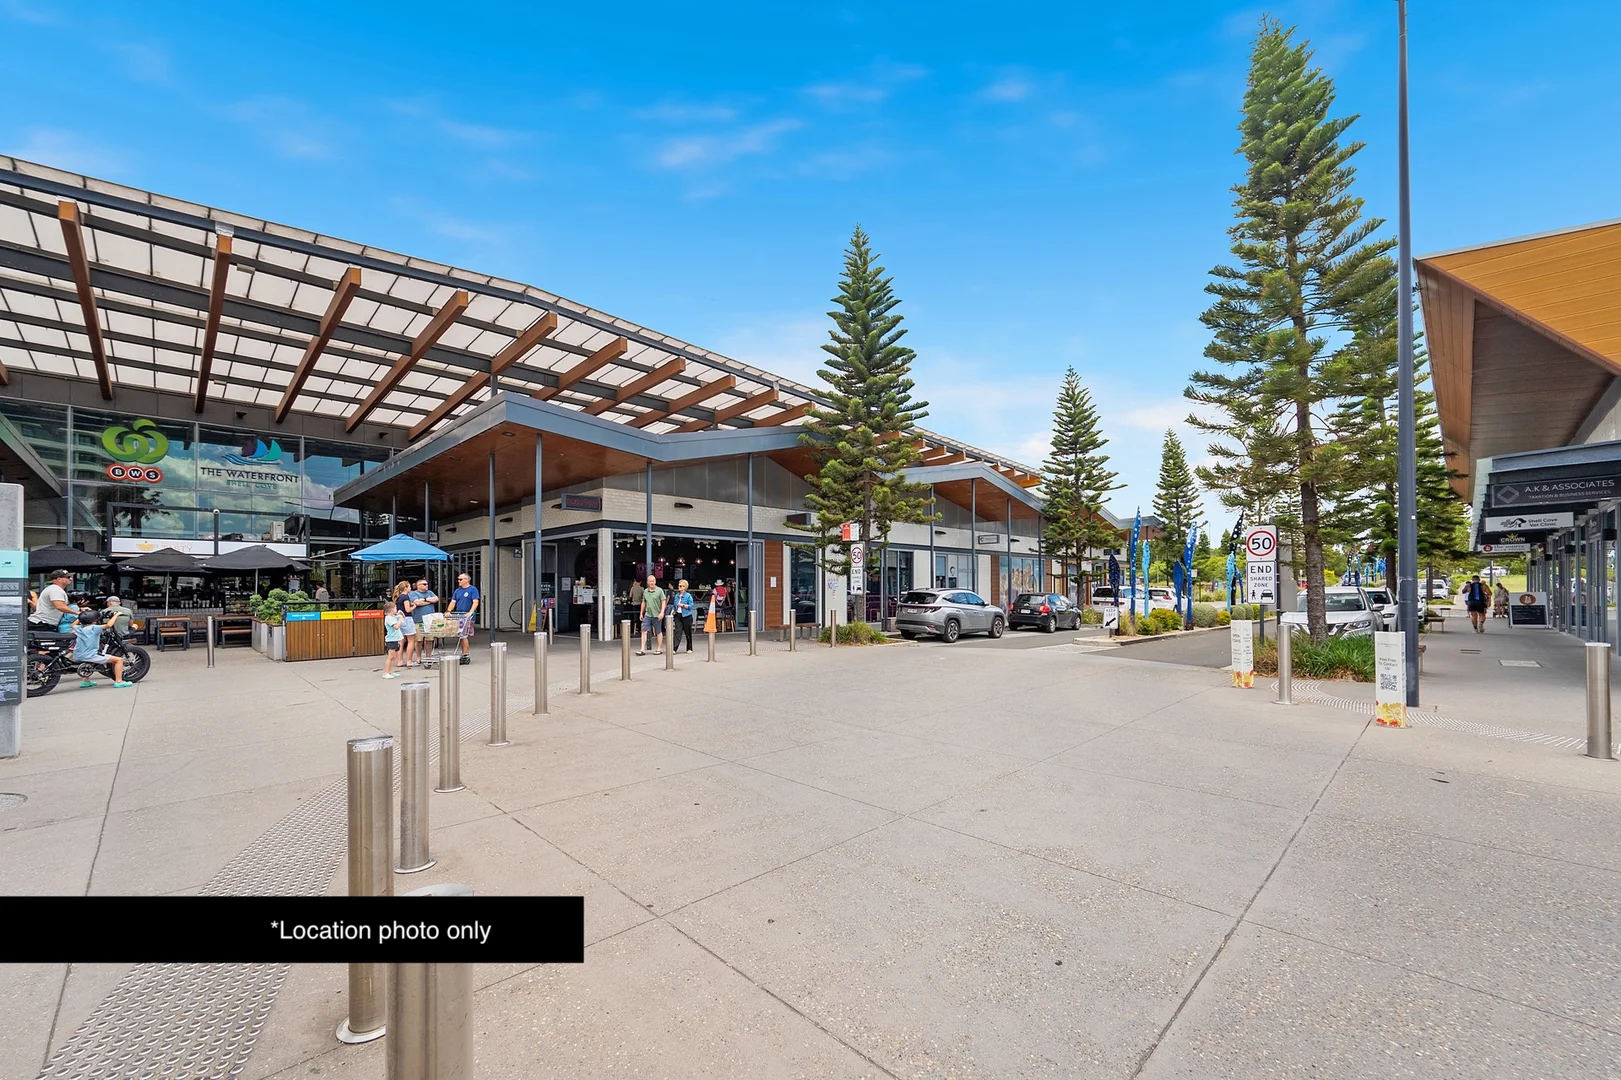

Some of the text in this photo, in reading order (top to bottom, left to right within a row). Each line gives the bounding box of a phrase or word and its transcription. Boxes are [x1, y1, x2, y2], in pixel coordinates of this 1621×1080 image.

[112, 467, 159, 479] BWS
[200, 467, 299, 483] THE WATERFRONT
[1525, 479, 1615, 493] A.K & ASSOCIATES
[161, 544, 193, 553] TSTY
[1251, 537, 1272, 551] 50
[1250, 565, 1272, 574] END
